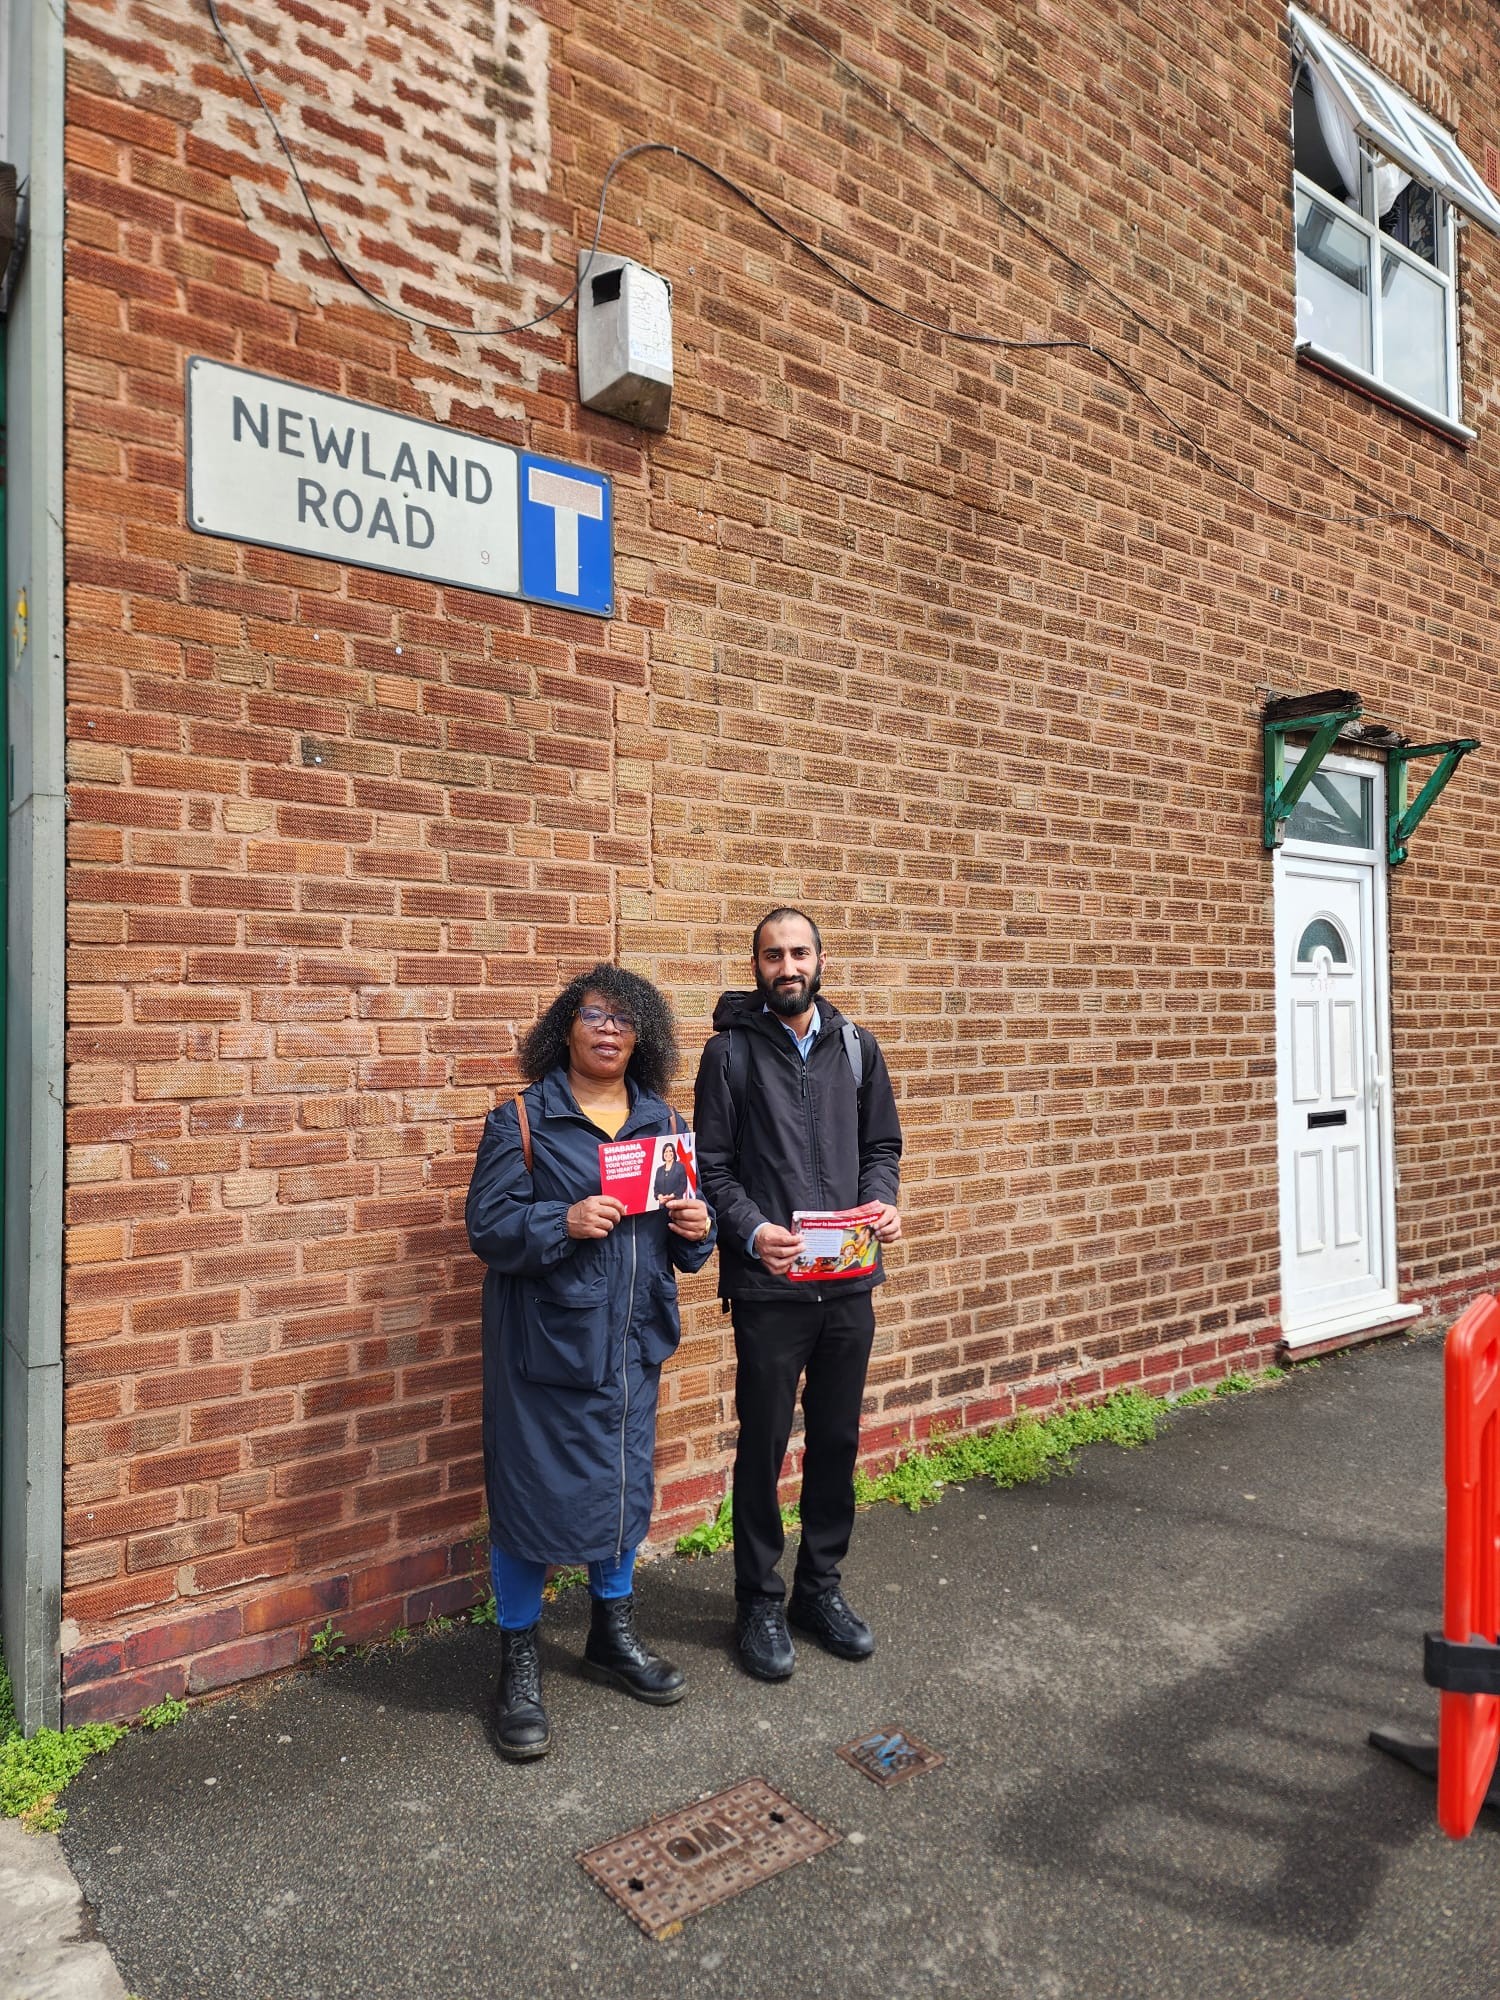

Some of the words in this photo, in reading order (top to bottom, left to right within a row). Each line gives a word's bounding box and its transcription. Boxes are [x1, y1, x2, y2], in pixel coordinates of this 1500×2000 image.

[232, 395, 493, 505] NEWLAND
[297, 477, 435, 549] ROAD
[480, 550, 491, 565] 9
[604, 1144, 642, 1154] SHABANA
[605, 1151, 646, 1162] MAHMOOD
[606, 1171, 642, 1181] GOVERNMENT
